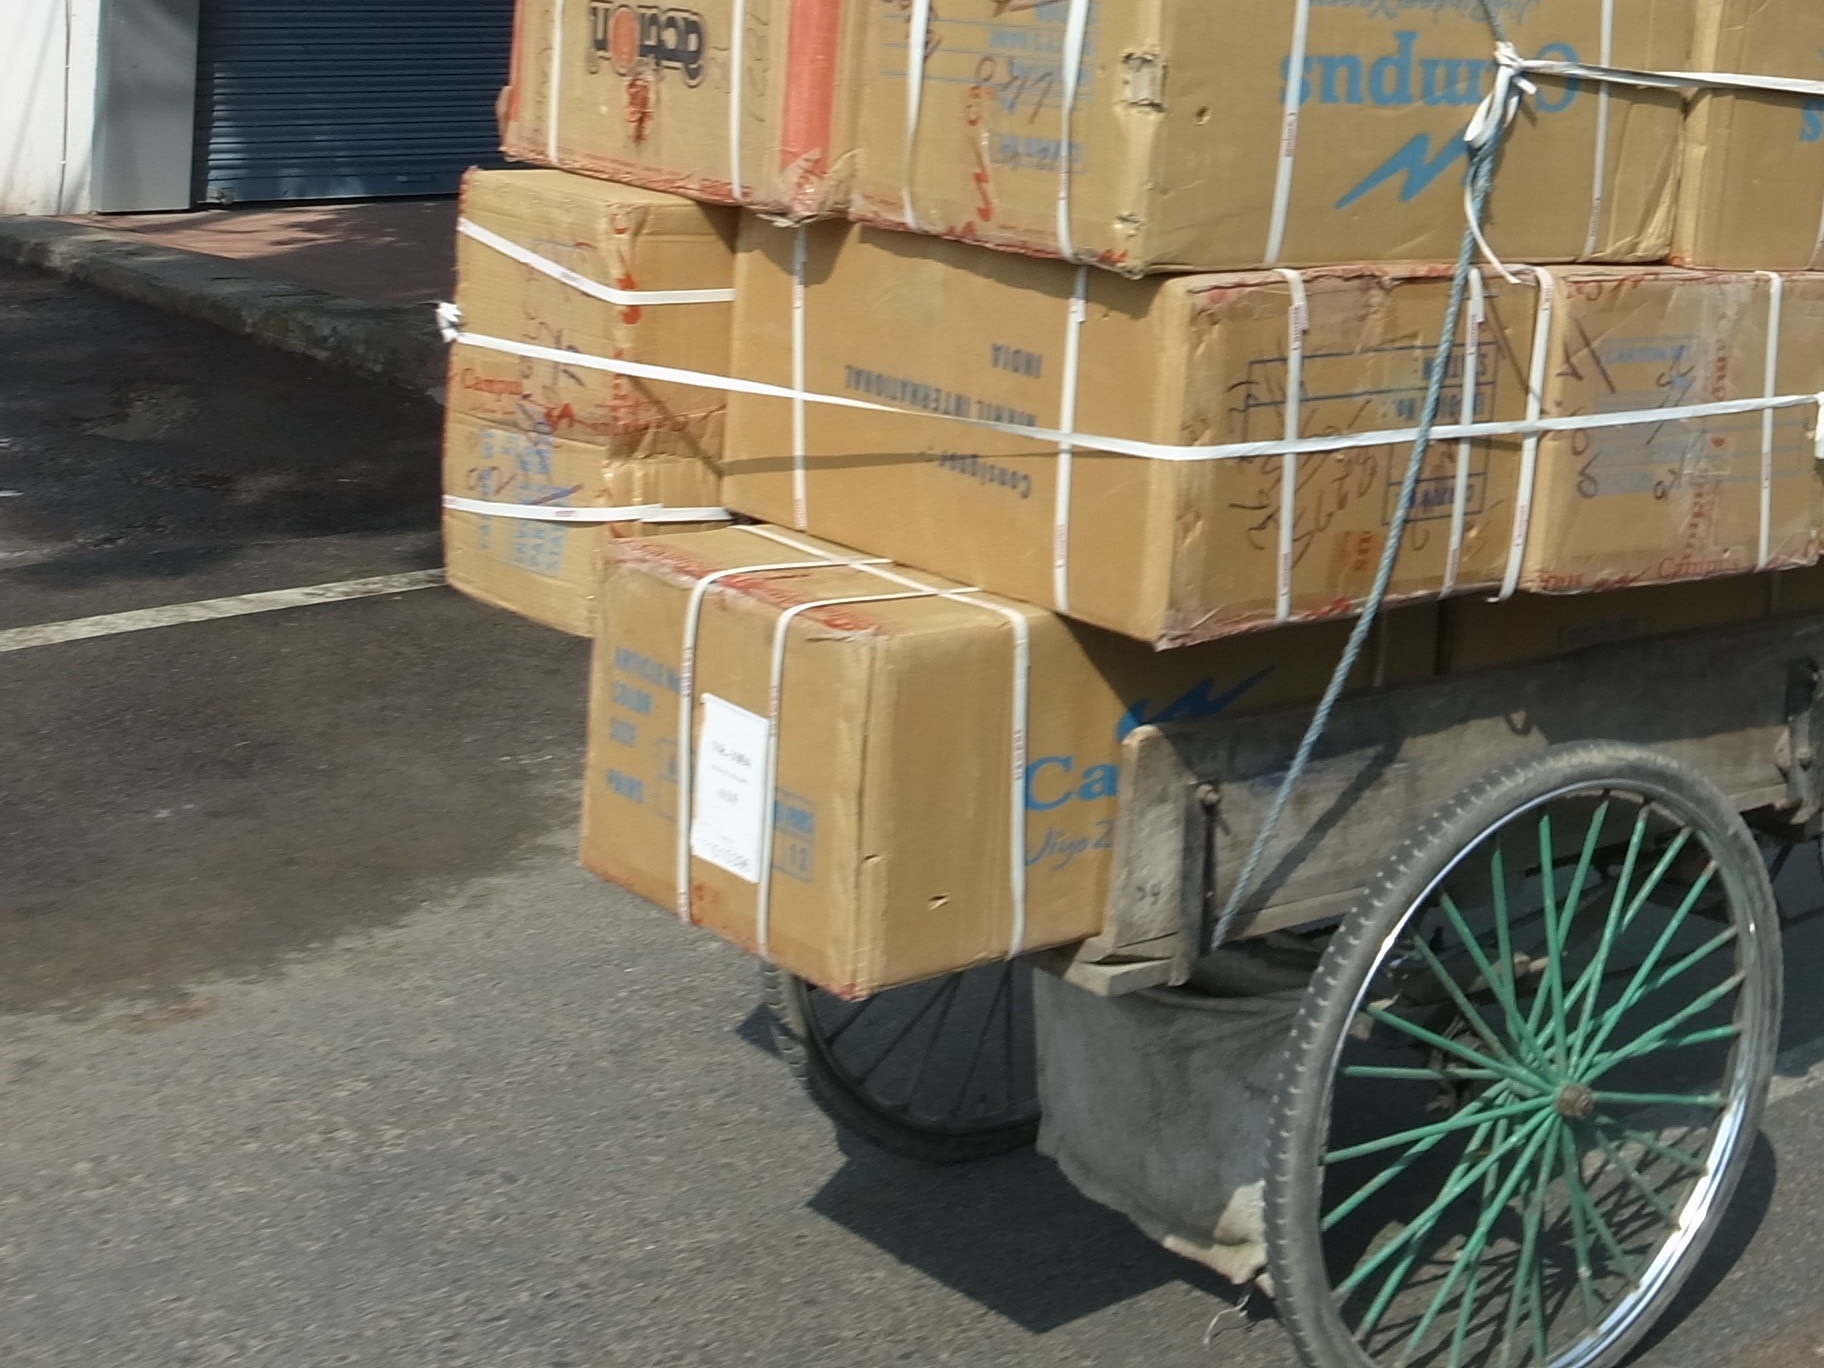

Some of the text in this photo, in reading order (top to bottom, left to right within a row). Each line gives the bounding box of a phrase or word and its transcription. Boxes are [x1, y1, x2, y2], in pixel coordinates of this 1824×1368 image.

[587, 0, 705, 91] action
[1278, 31, 1580, 114] Cmpus
[990, 343, 1042, 380] INDIA
